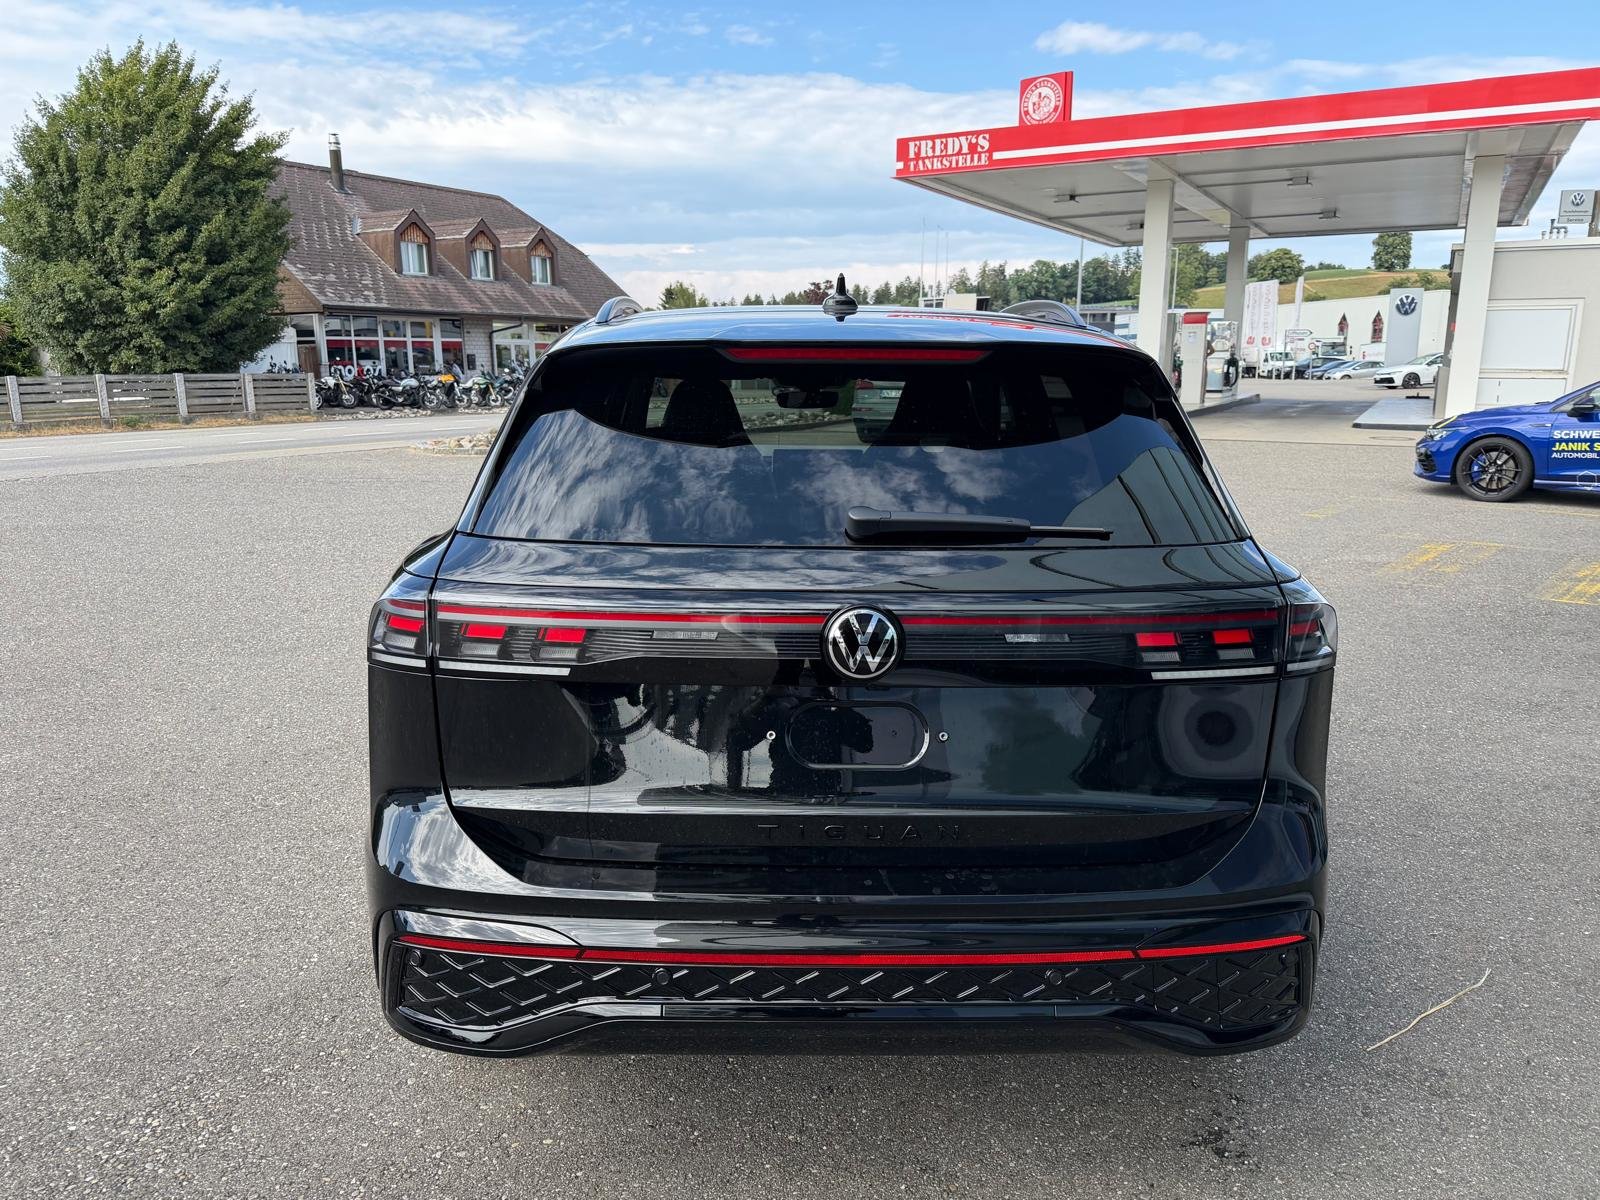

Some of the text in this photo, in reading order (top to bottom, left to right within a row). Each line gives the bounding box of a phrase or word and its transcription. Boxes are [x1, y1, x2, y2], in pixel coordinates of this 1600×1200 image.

[908, 152, 990, 172] TANKSTELLE
[1553, 430, 1600, 439] SCHWE
[1551, 442, 1591, 451] JANIK
[757, 823, 961, 841] TIGUAN
